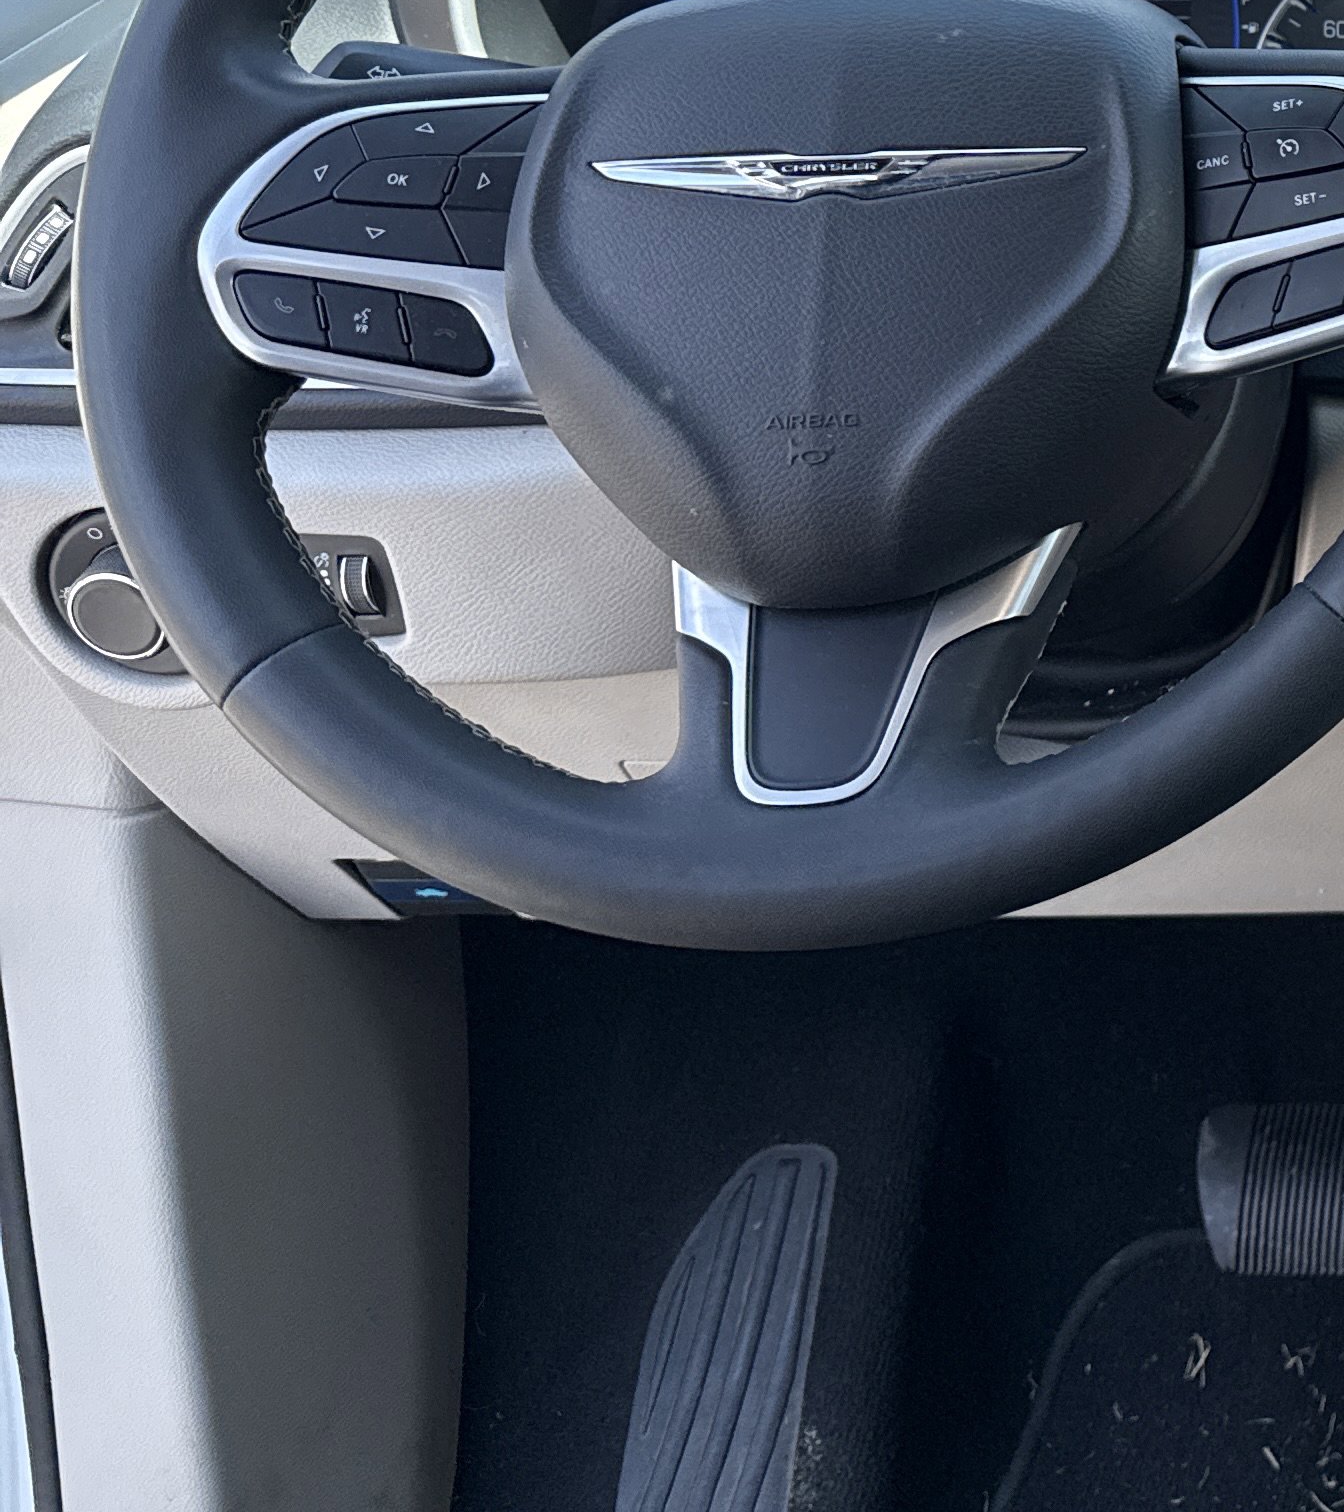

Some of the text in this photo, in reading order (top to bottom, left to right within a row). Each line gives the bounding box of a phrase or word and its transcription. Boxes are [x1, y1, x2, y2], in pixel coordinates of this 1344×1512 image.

[781, 162, 878, 172] CHRYSLER
[1196, 154, 1230, 170] CANC
[386, 173, 409, 187] OK
[765, 413, 860, 430] AIRBAG
